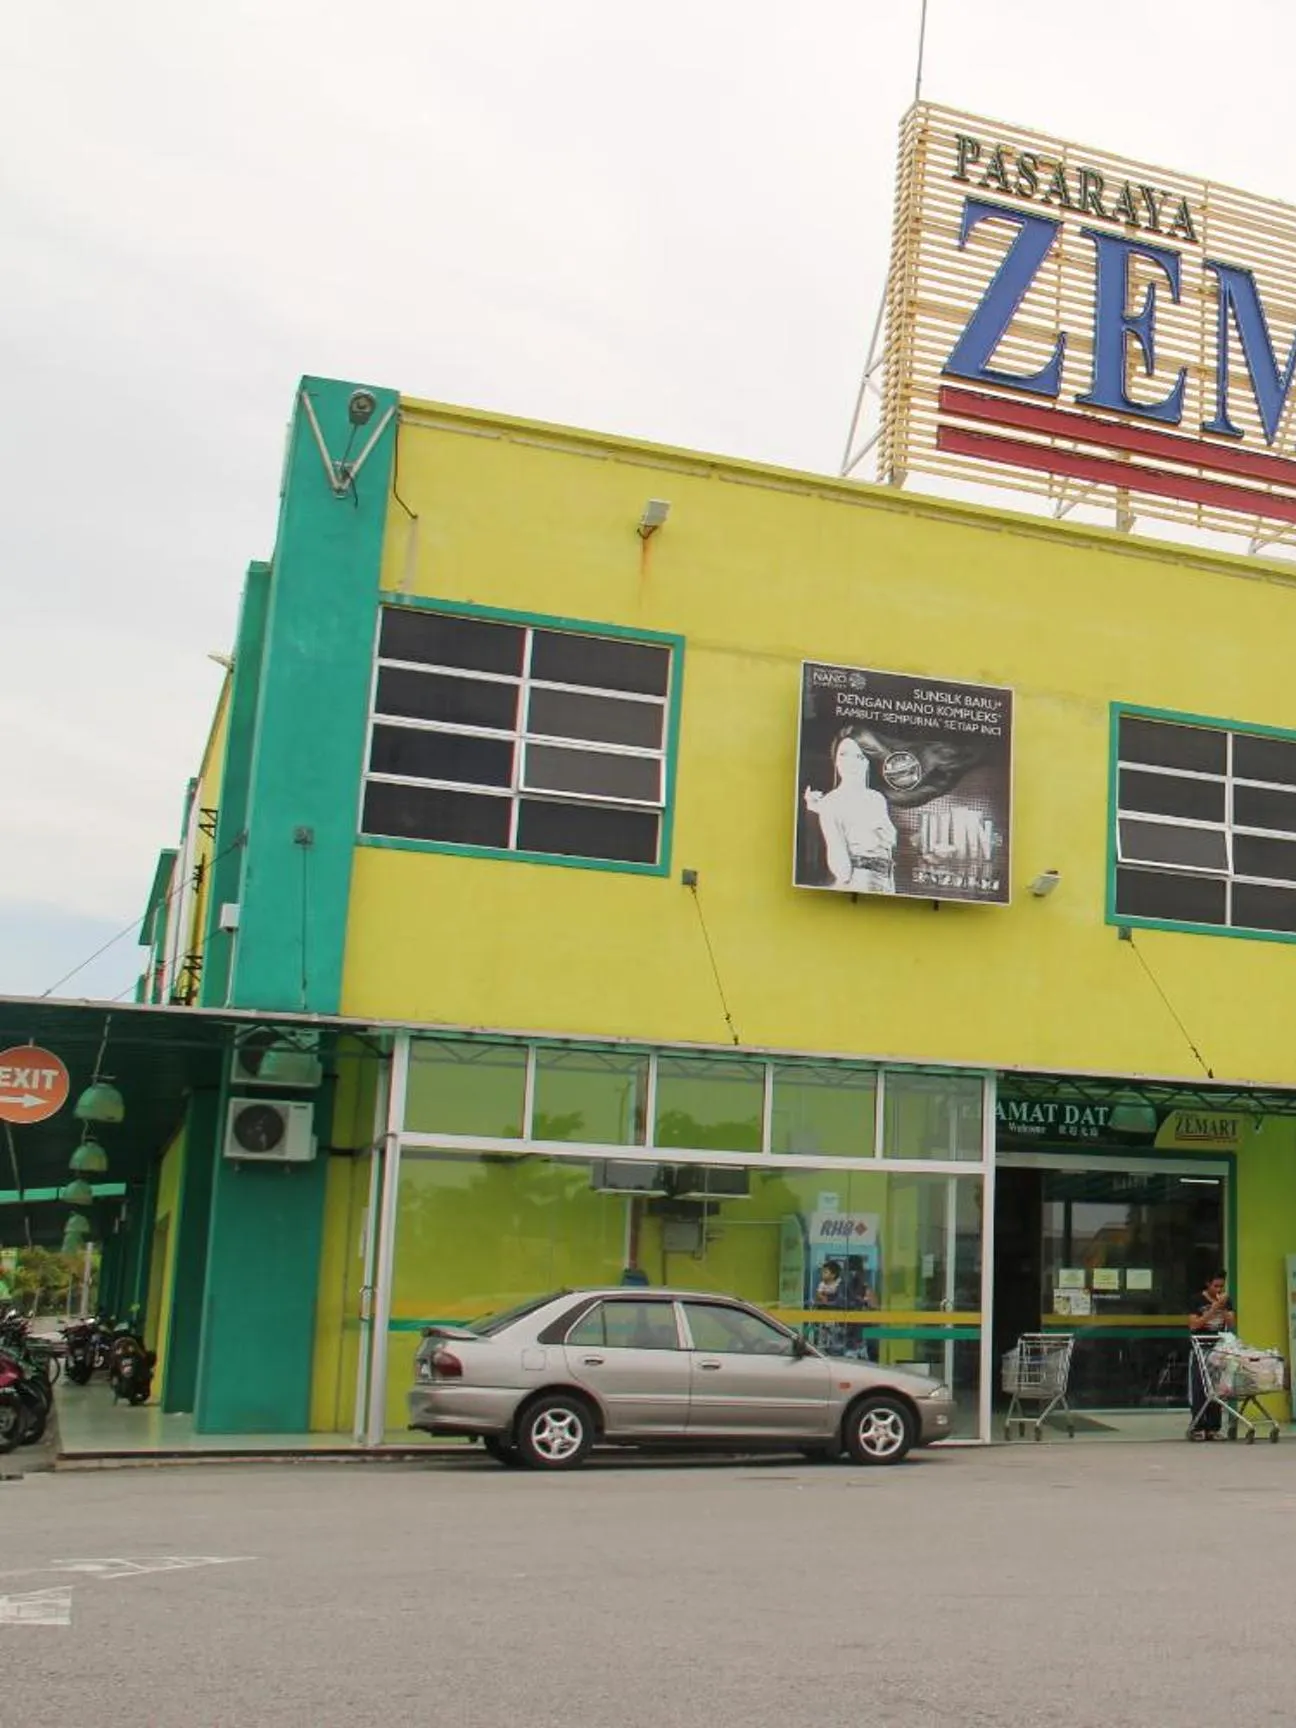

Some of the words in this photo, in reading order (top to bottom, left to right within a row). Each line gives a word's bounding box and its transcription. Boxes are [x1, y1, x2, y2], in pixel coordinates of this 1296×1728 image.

[952, 133, 1199, 242] PASARAYA
[837, 692, 892, 710] DENGAN
[895, 700, 934, 714] NANO
[913, 688, 962, 705] SUNSILK
[835, 705, 880, 721] RAMBUT
[0, 1066, 59, 1091] EXIT
[1063, 1104, 1109, 1127] DAT
[1175, 1114, 1239, 1136] ZEMART
[820, 1219, 854, 1237] RHB
